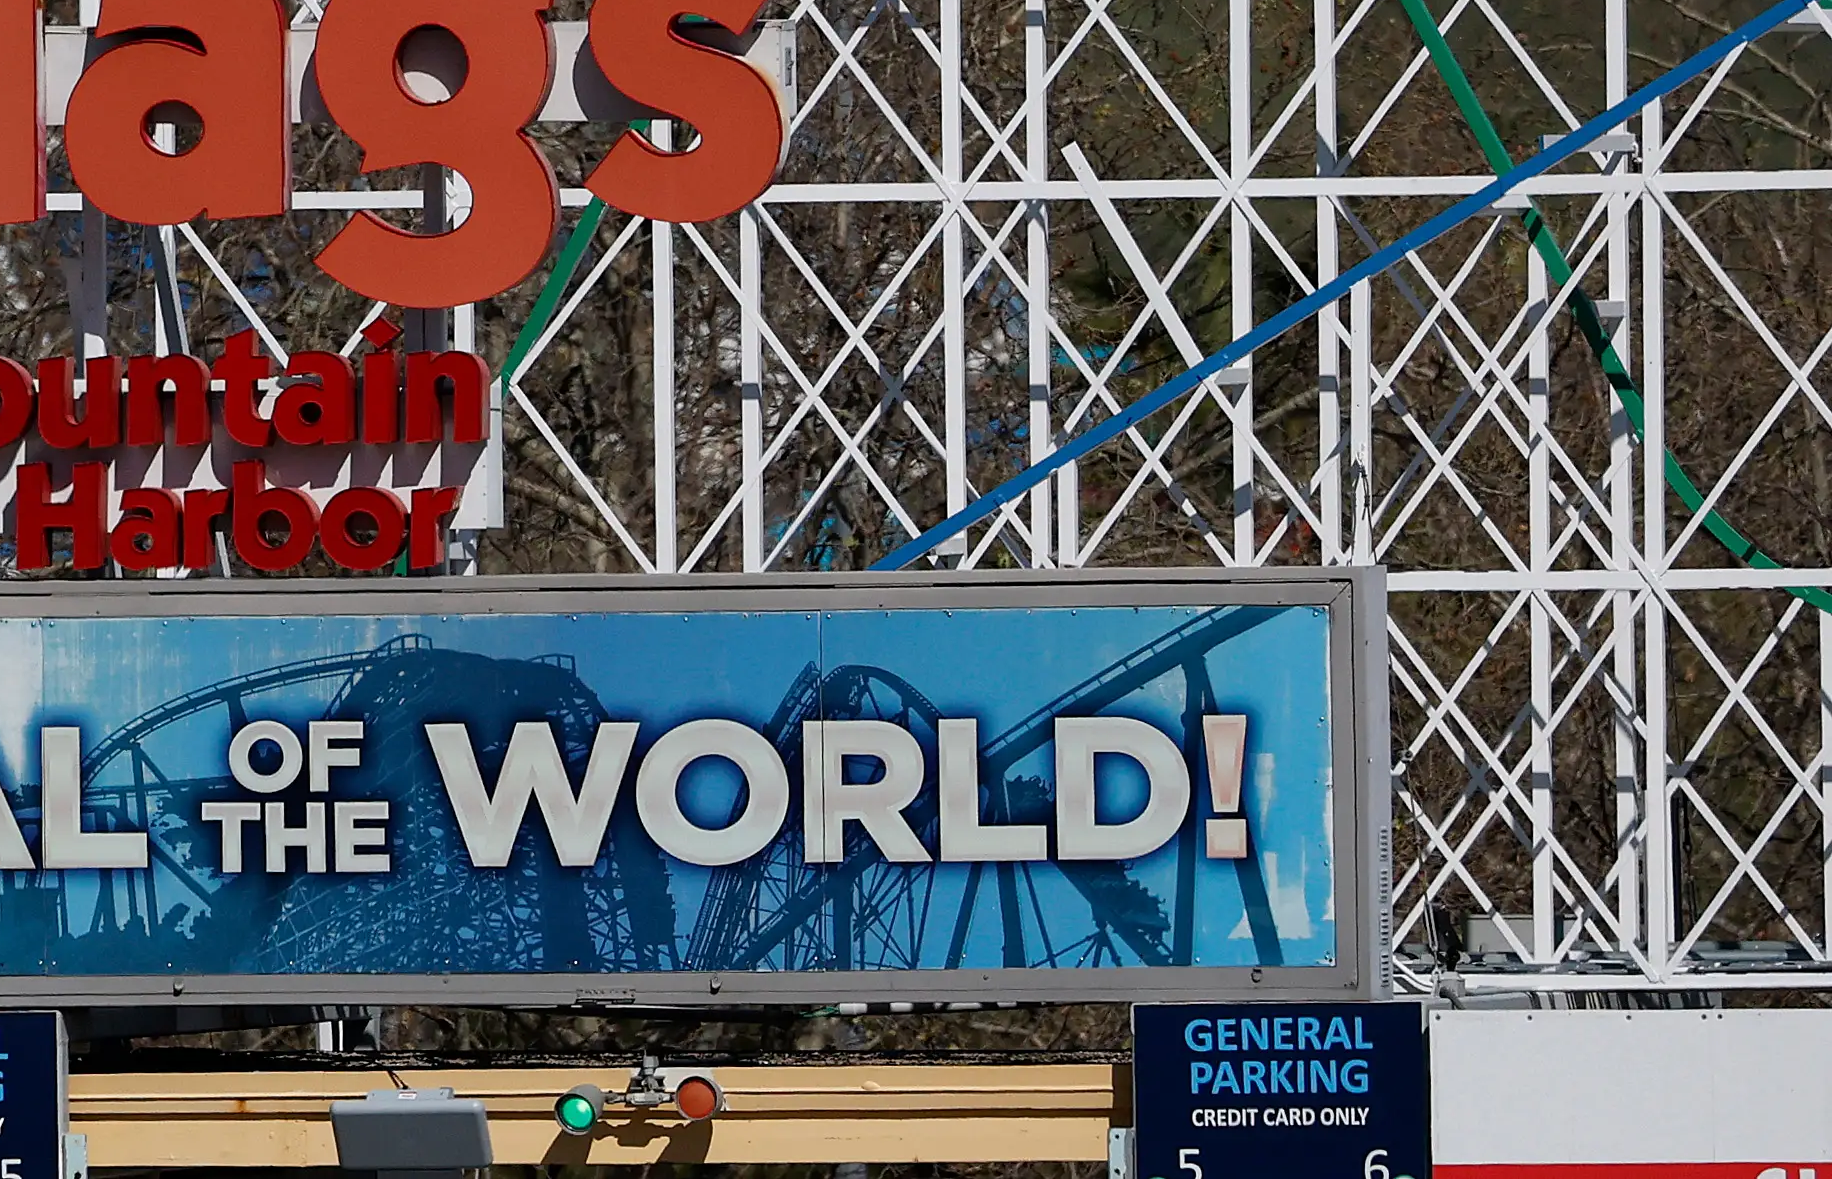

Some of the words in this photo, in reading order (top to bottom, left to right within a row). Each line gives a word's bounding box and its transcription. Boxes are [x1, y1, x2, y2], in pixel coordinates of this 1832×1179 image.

[16, 458, 460, 571] Harbor
[228, 720, 365, 793] OF
[424, 714, 1248, 868] WORLD!
[201, 801, 391, 874] THE
[1184, 1016, 1374, 1052] GENERAL
[1190, 1059, 1369, 1094] PARKING
[1191, 1108, 1259, 1127] CREDIT
[1263, 1107, 1316, 1126] CARD
[1320, 1106, 1370, 1126] ONLY
[1178, 1148, 1203, 1179] 5
[1364, 1149, 1390, 1179] 6
